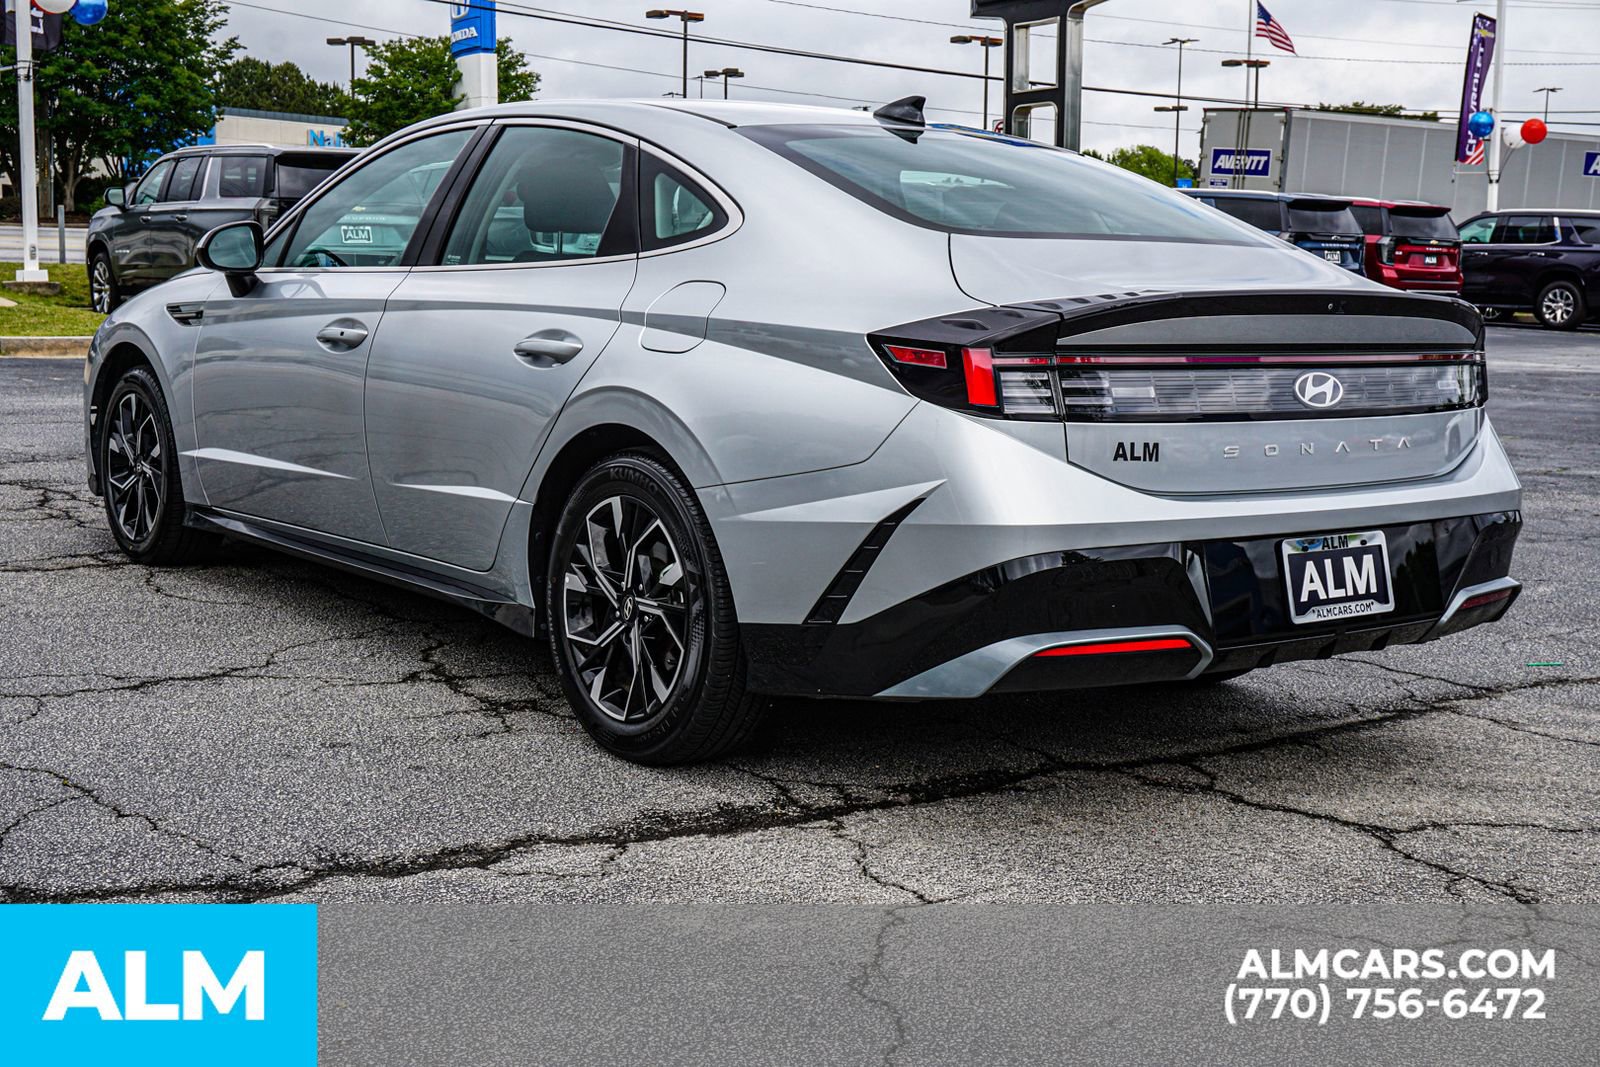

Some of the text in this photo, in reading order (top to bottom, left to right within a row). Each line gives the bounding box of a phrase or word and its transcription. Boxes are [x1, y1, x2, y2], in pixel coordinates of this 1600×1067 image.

[1213, 154, 1268, 170] AVERITT
[346, 229, 368, 239] ALM
[1112, 442, 1160, 462] ALM
[1222, 436, 1411, 459] SONATA
[609, 467, 659, 494] KUMHO
[1321, 535, 1349, 550] ALM
[1299, 554, 1378, 602] ALM
